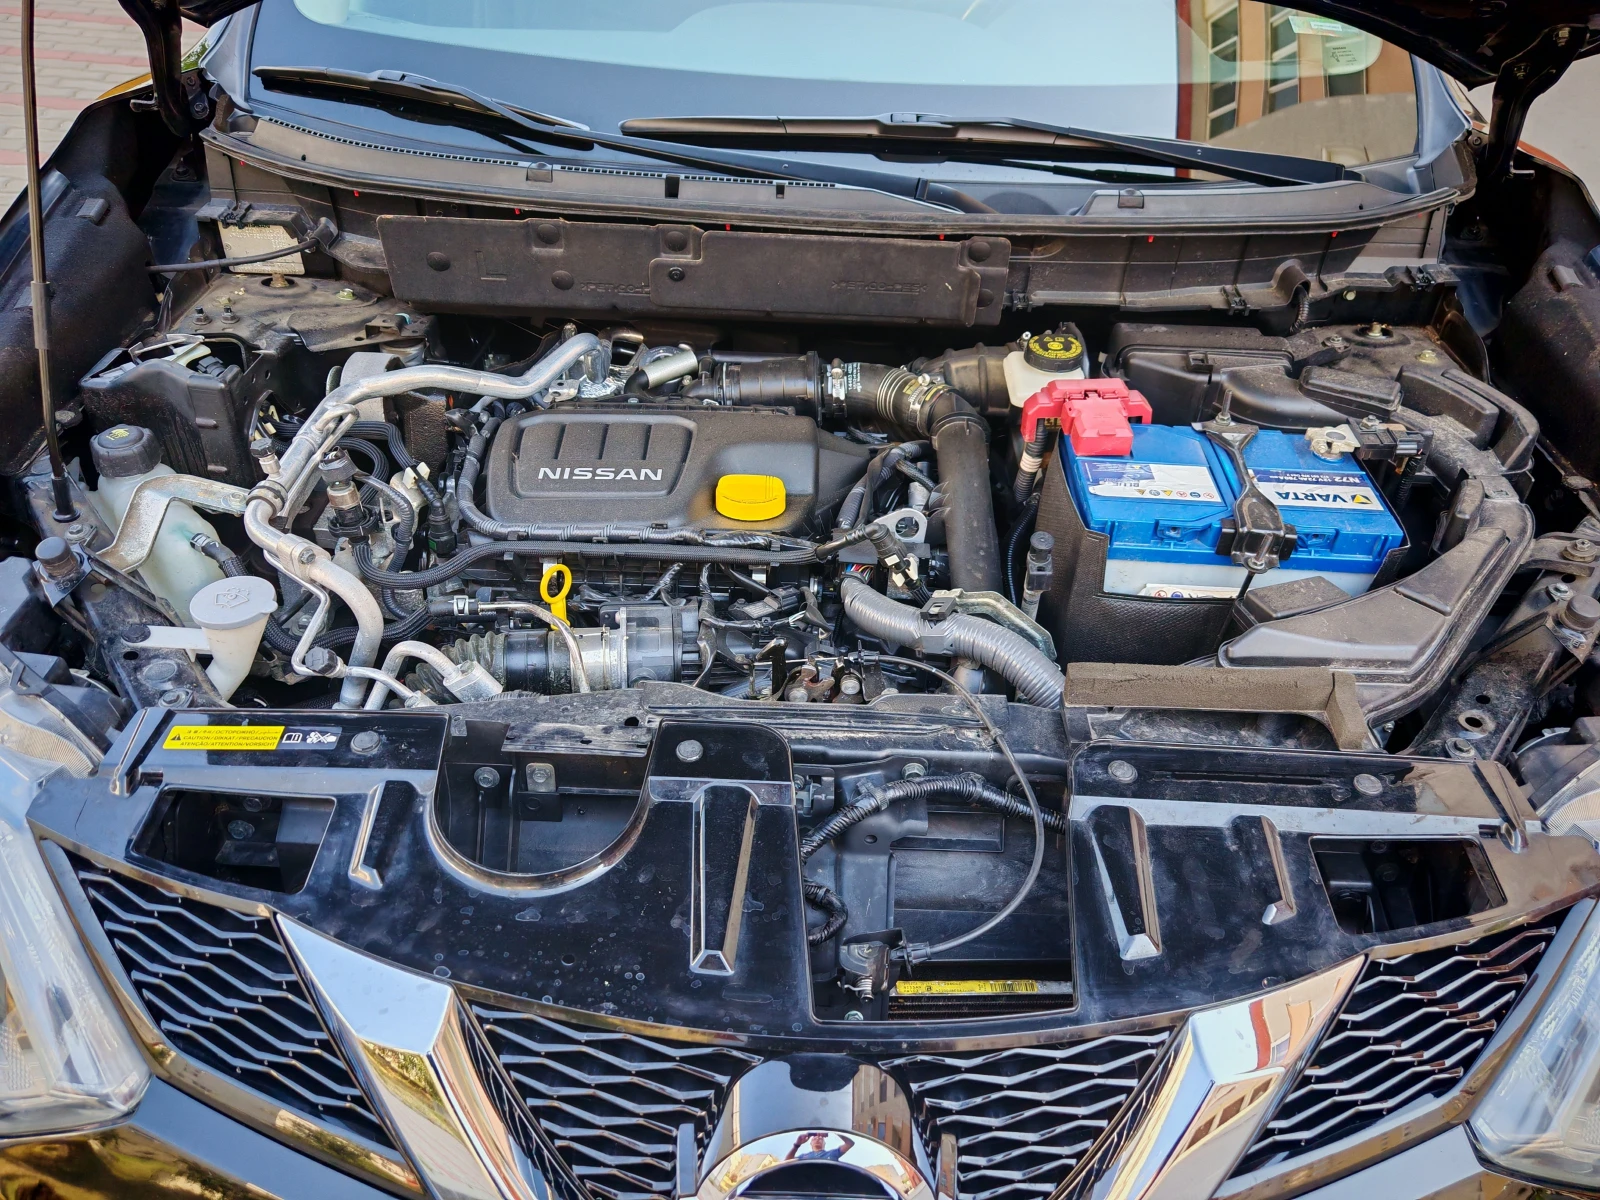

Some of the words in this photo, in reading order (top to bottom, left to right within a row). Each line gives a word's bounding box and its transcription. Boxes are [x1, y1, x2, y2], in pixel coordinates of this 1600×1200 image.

[538, 467, 663, 481] NISSAN
[1333, 476, 1361, 484] N72
[1274, 491, 1349, 503] VARTA
